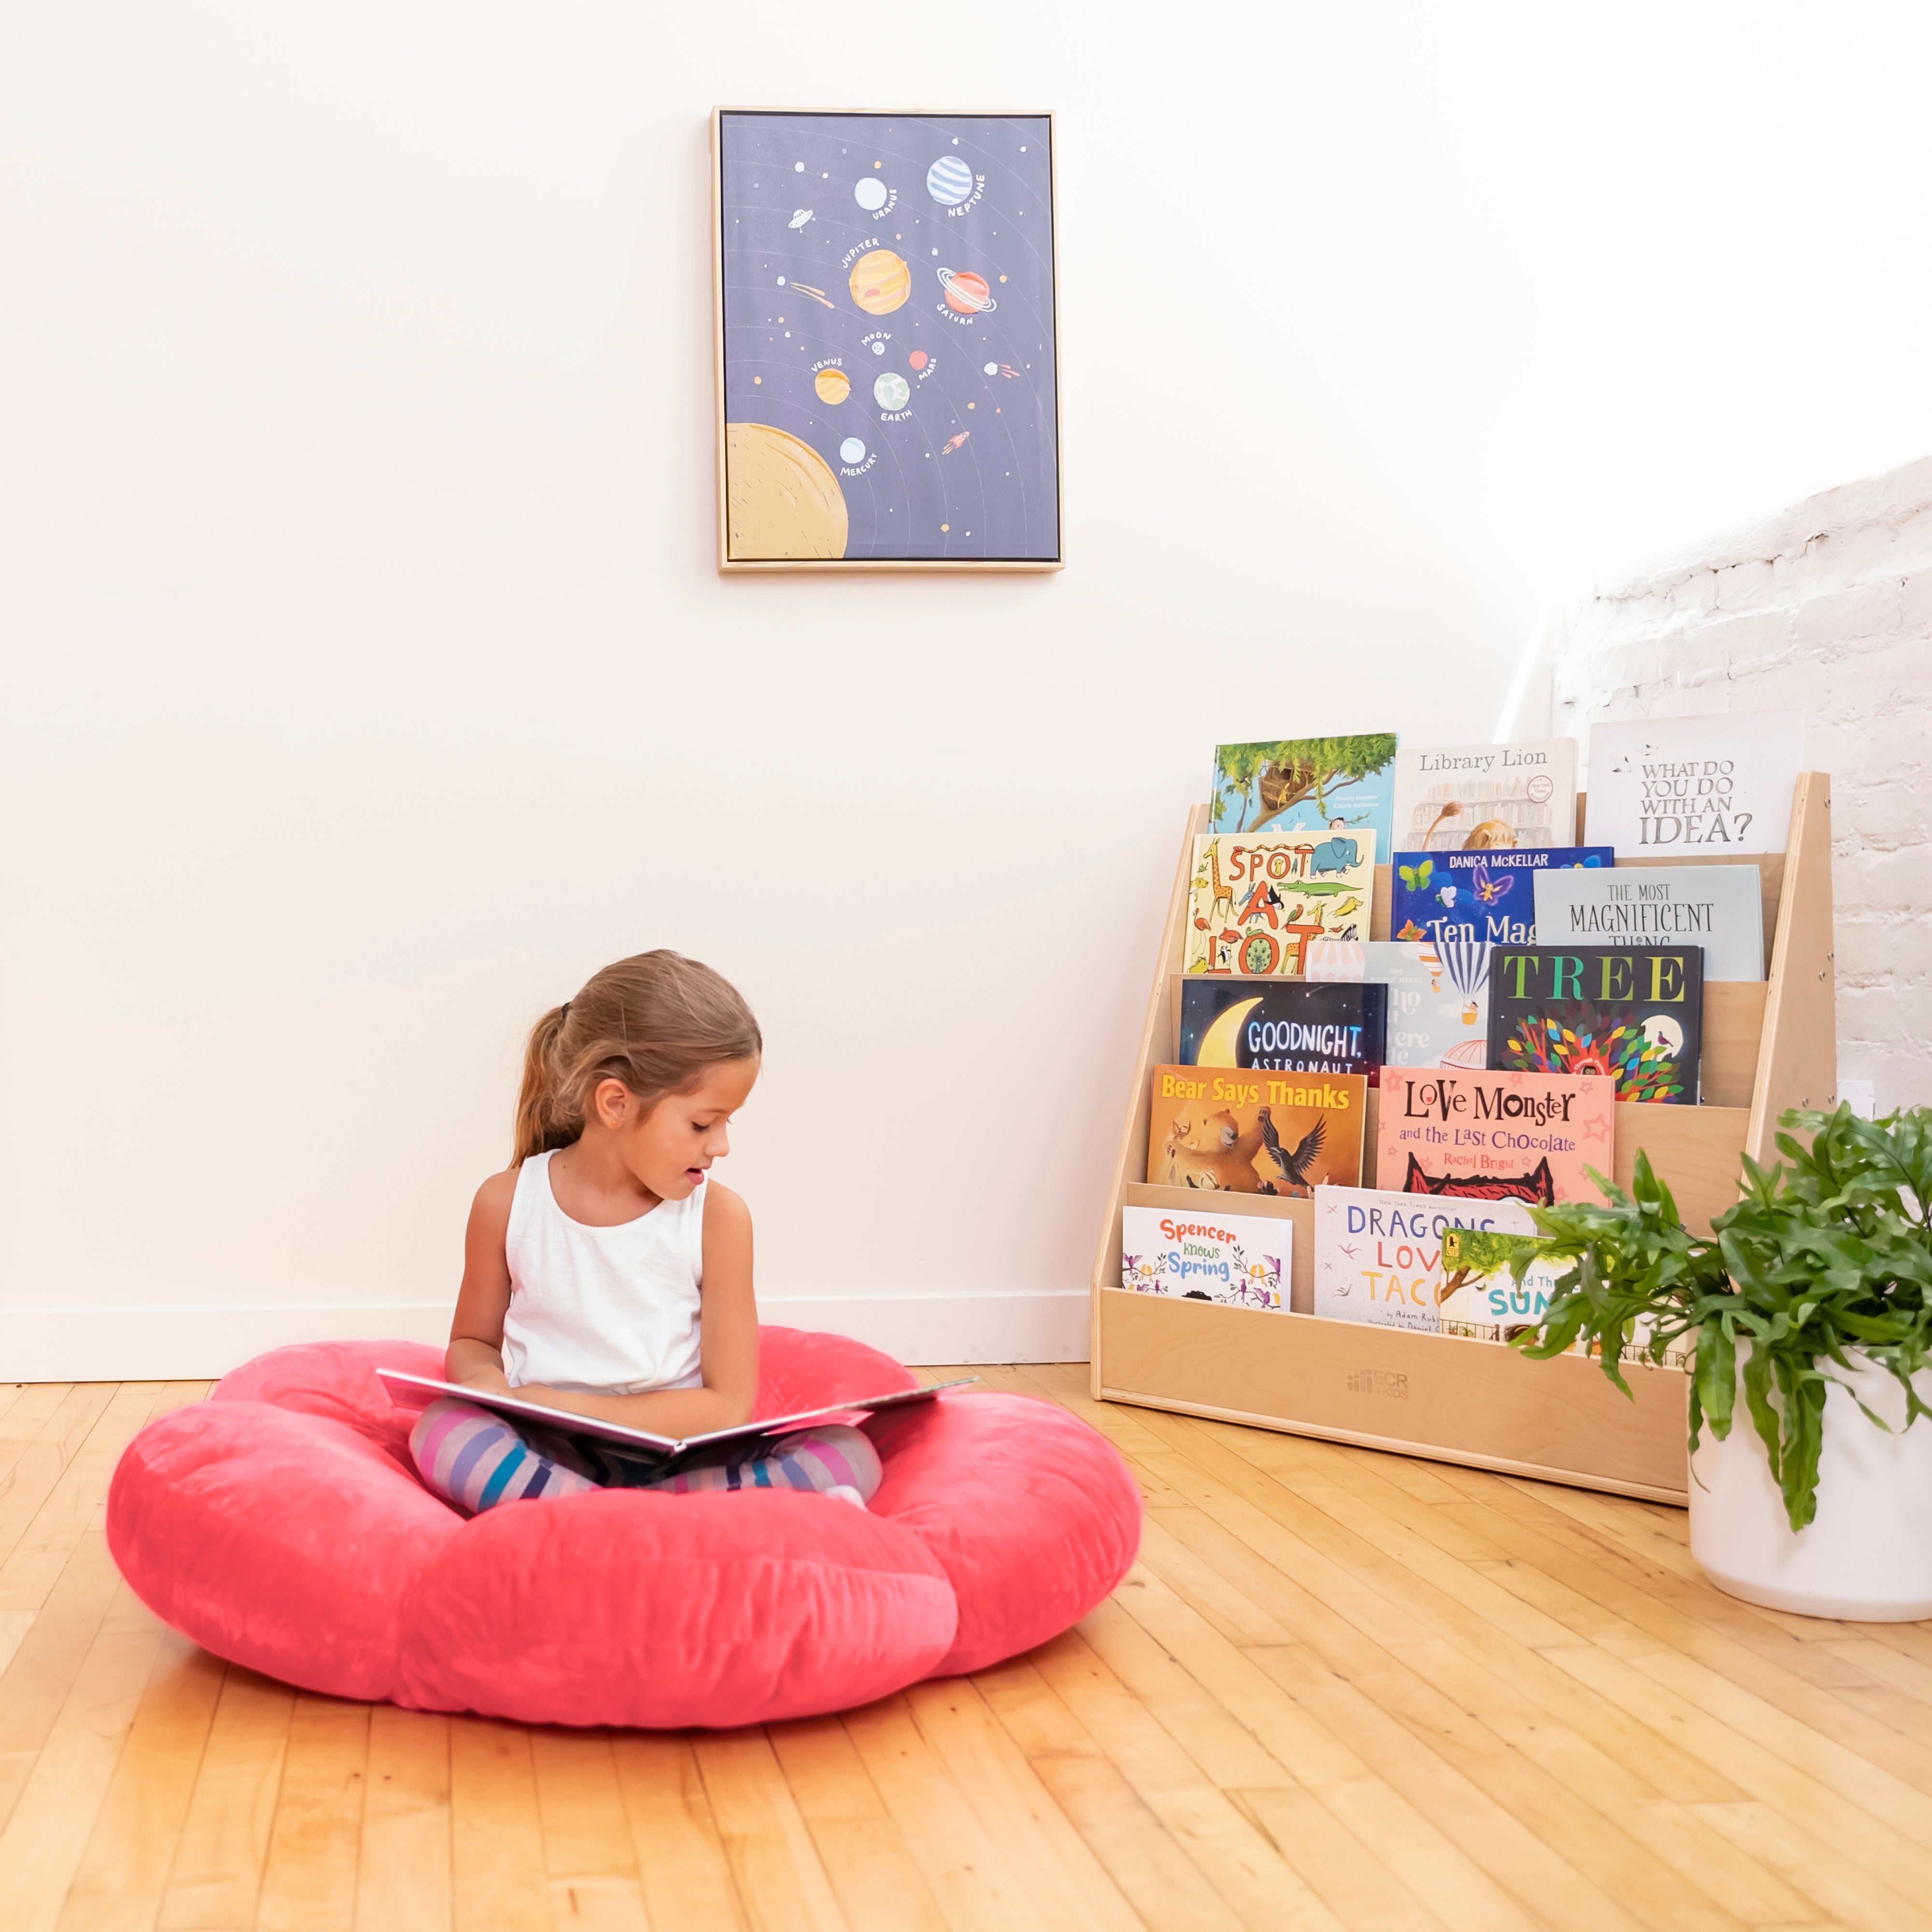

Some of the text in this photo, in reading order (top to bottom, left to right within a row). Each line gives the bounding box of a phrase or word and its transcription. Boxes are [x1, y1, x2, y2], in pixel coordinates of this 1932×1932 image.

[872, 188, 897, 221] URANUS
[948, 174, 985, 217] NEPTUNE
[842, 237, 880, 269] JUPITER
[936, 302, 973, 325] SATURN
[861, 332, 891, 346] MOON
[811, 357, 843, 373] VENUS
[918, 357, 937, 381] MARS
[881, 410, 912, 422] EARTH
[840, 453, 878, 477] MERCURY
[1419, 749, 1548, 773] Library Lion
[1642, 761, 1734, 779] WHAT DO
[1641, 777, 1733, 798] YOU DO
[1641, 797, 1732, 815] WITH AN
[1638, 813, 1753, 845] IDEA?
[1229, 849, 1315, 881] SPOT
[1449, 853, 1548, 868] DANICA McKELLAR
[1607, 884, 1670, 901] THE MOST
[1237, 881, 1279, 930] A
[1426, 916, 1475, 943] Ten
[1569, 903, 1714, 933] MAGNIFICENT
[1208, 924, 1325, 975] LOT
[1504, 956, 1685, 1002] TREE
[1393, 988, 1421, 1015] ho
[1248, 1021, 1362, 1058] GOODNIGHT,
[1251, 1058, 1353, 1074] ASTRONAUT
[1162, 1075, 1350, 1110] Bear Says Thanks
[1473, 1087, 1576, 1126] Monster
[1399, 1128, 1421, 1140] and
[1425, 1126, 1448, 1144] the
[1492, 1130, 1576, 1152] Chocolate
[1443, 1153, 1514, 1171] Rachel Bright
[1160, 1219, 1236, 1244] Spencer
[1183, 1242, 1221, 1259] knows
[1167, 1251, 1230, 1282] Spring
[1361, 1271, 1440, 1307] TAC
[1538, 1276, 1555, 1287] Th
[1387, 1310, 1393, 1319] by
[1396, 1310, 1418, 1320] Adam
[1374, 1370, 1408, 1389] ECR
